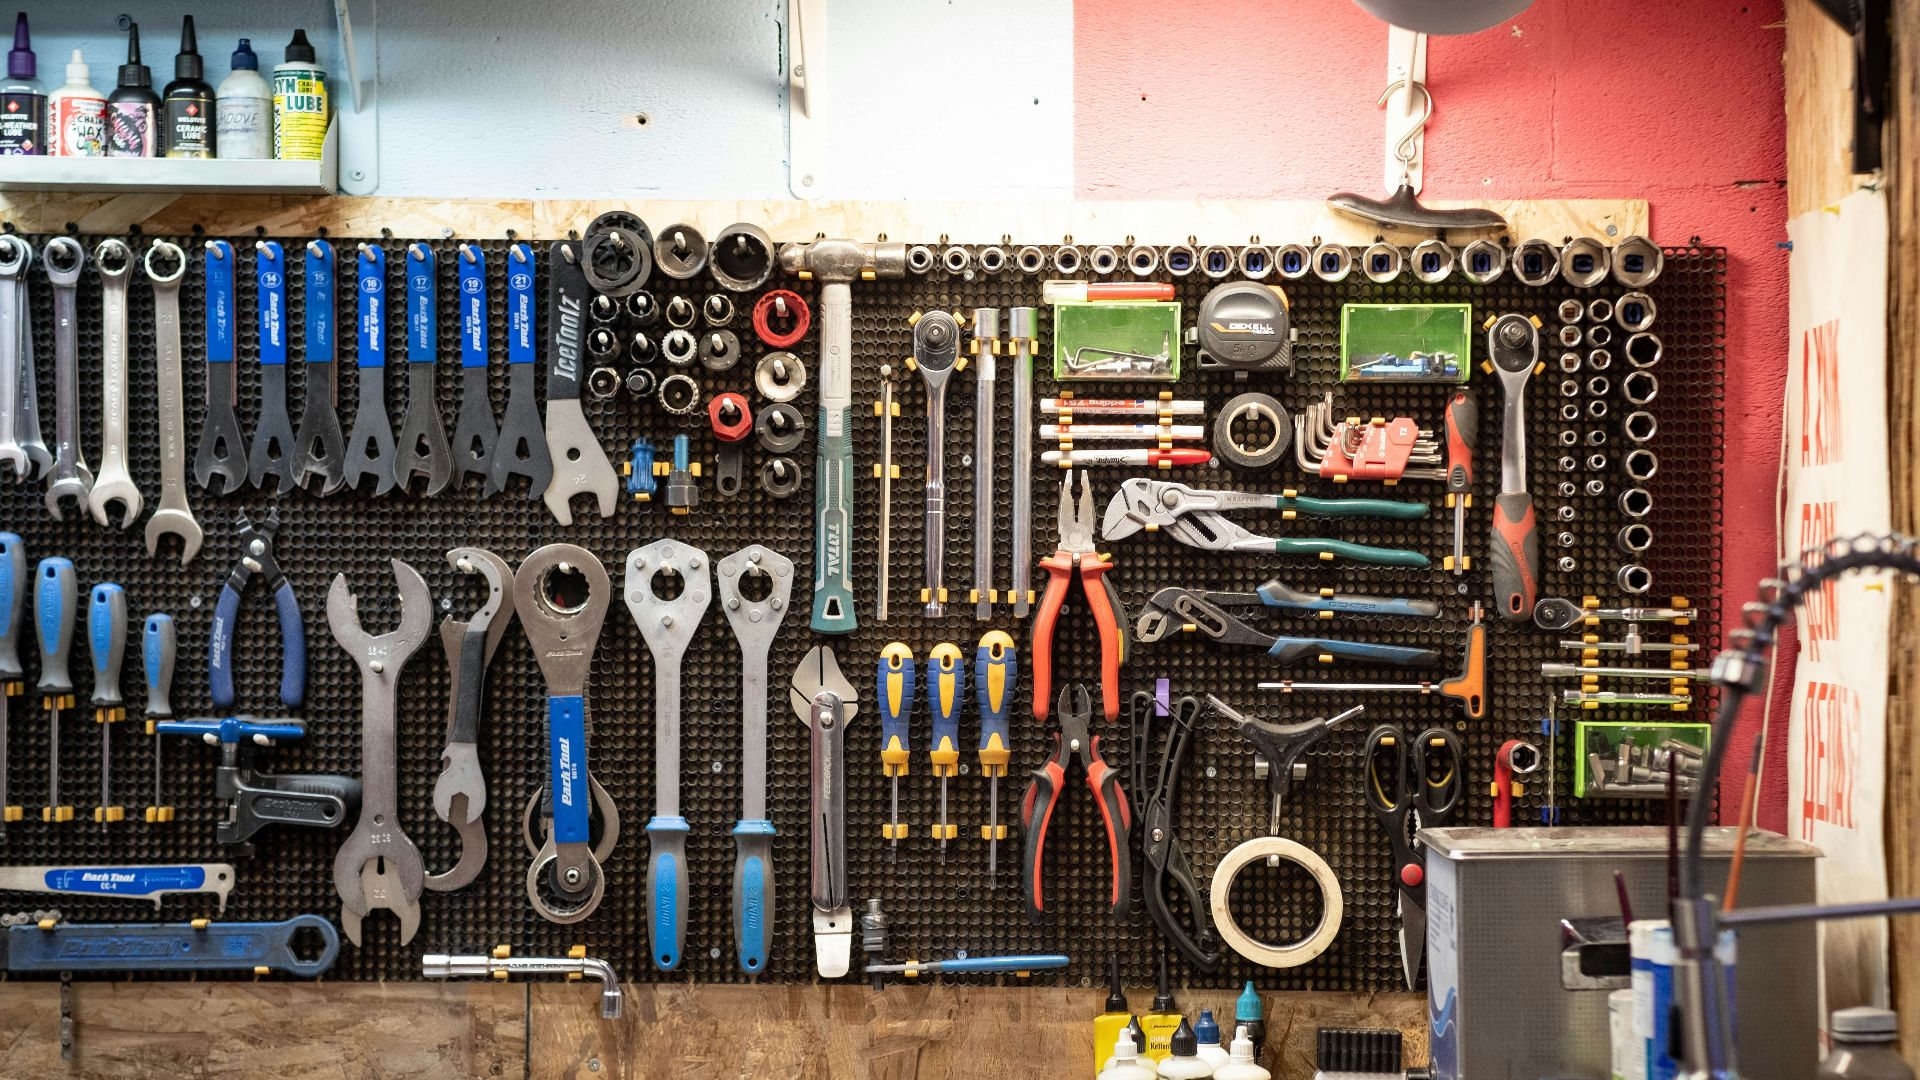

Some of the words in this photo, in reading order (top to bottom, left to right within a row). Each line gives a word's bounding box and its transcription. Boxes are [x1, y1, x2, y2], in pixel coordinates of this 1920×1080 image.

[286, 96, 322, 111] LUBE
[554, 294, 580, 382] IceToolz
[827, 524, 840, 577] TOTAL
[559, 737, 570, 772] Tool
[561, 771, 572, 806] Park
[824, 756, 832, 800] FEEDBACK
[82, 872, 110, 882] Park
[110, 872, 136, 882] Tool
